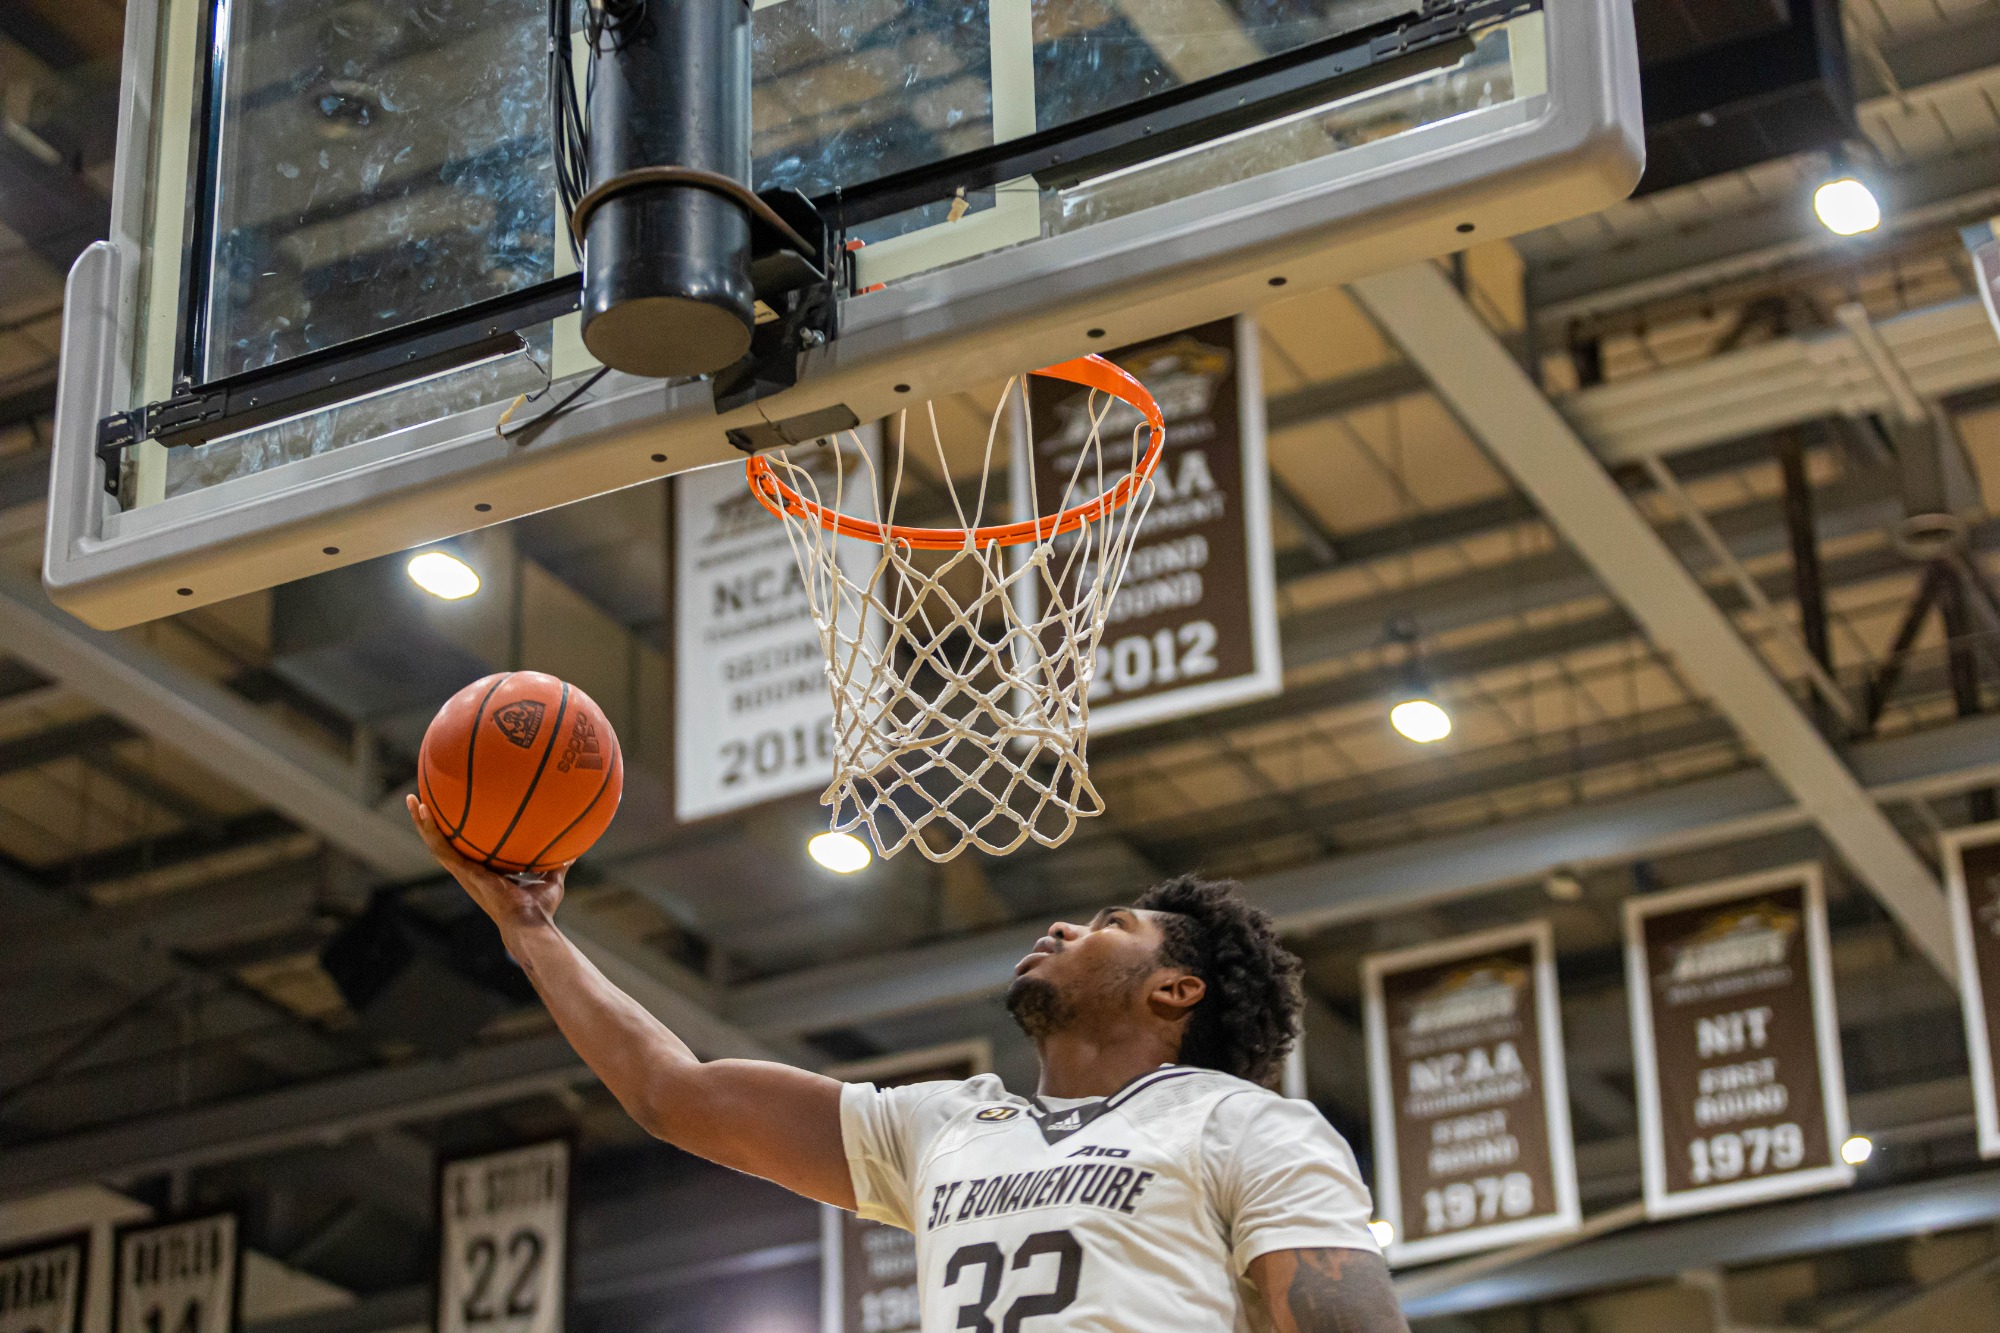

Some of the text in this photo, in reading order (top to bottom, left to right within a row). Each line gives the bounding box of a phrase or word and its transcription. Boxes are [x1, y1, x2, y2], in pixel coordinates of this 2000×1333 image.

[1080, 620, 1218, 699] 2012
[1689, 1122, 1805, 1184] 1979
[927, 1163, 1155, 1232] ST. BONAVENTURE
[464, 1227, 545, 1326] 22
[943, 1229, 1083, 1333] 32
